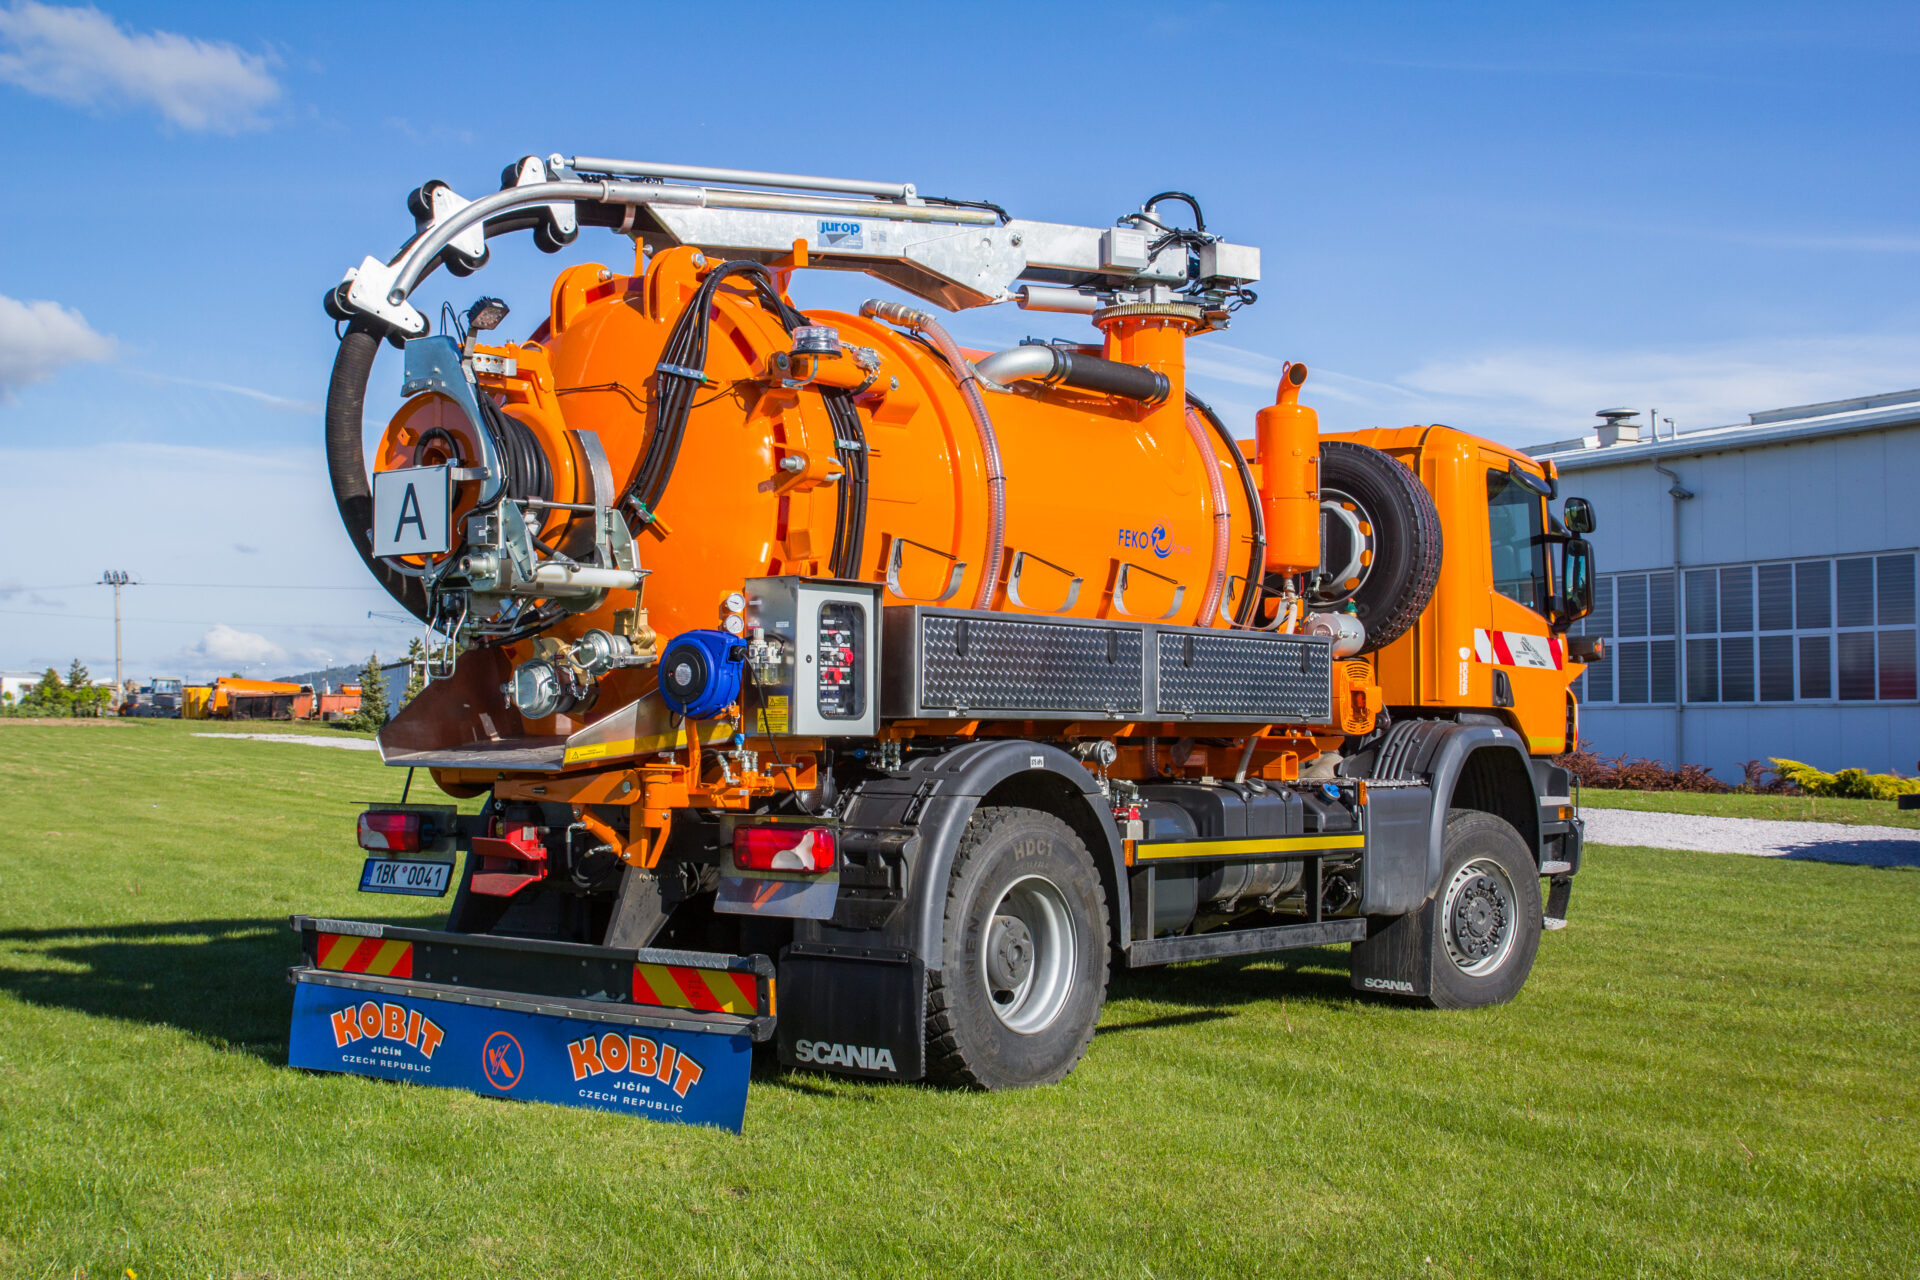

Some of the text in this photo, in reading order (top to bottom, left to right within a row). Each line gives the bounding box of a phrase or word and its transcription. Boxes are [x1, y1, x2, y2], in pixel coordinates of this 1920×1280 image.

[820, 220, 860, 236] jurop
[394, 482, 427, 543] A
[1118, 528, 1149, 549] FEKO
[1012, 838, 1053, 862] HDC1
[376, 863, 442, 887] 1BK 0041
[1363, 977, 1414, 992] SCANIA
[330, 1000, 447, 1060] KOBIT
[371, 1045, 402, 1057] JIČÍN
[795, 1039, 897, 1072] SCANIA
[342, 1054, 431, 1073] CZECH REPUBLIC
[567, 1031, 704, 1099] KOBIT
[613, 1080, 650, 1094] JIČÍN
[578, 1088, 683, 1114] CZECH REPUBLIC
